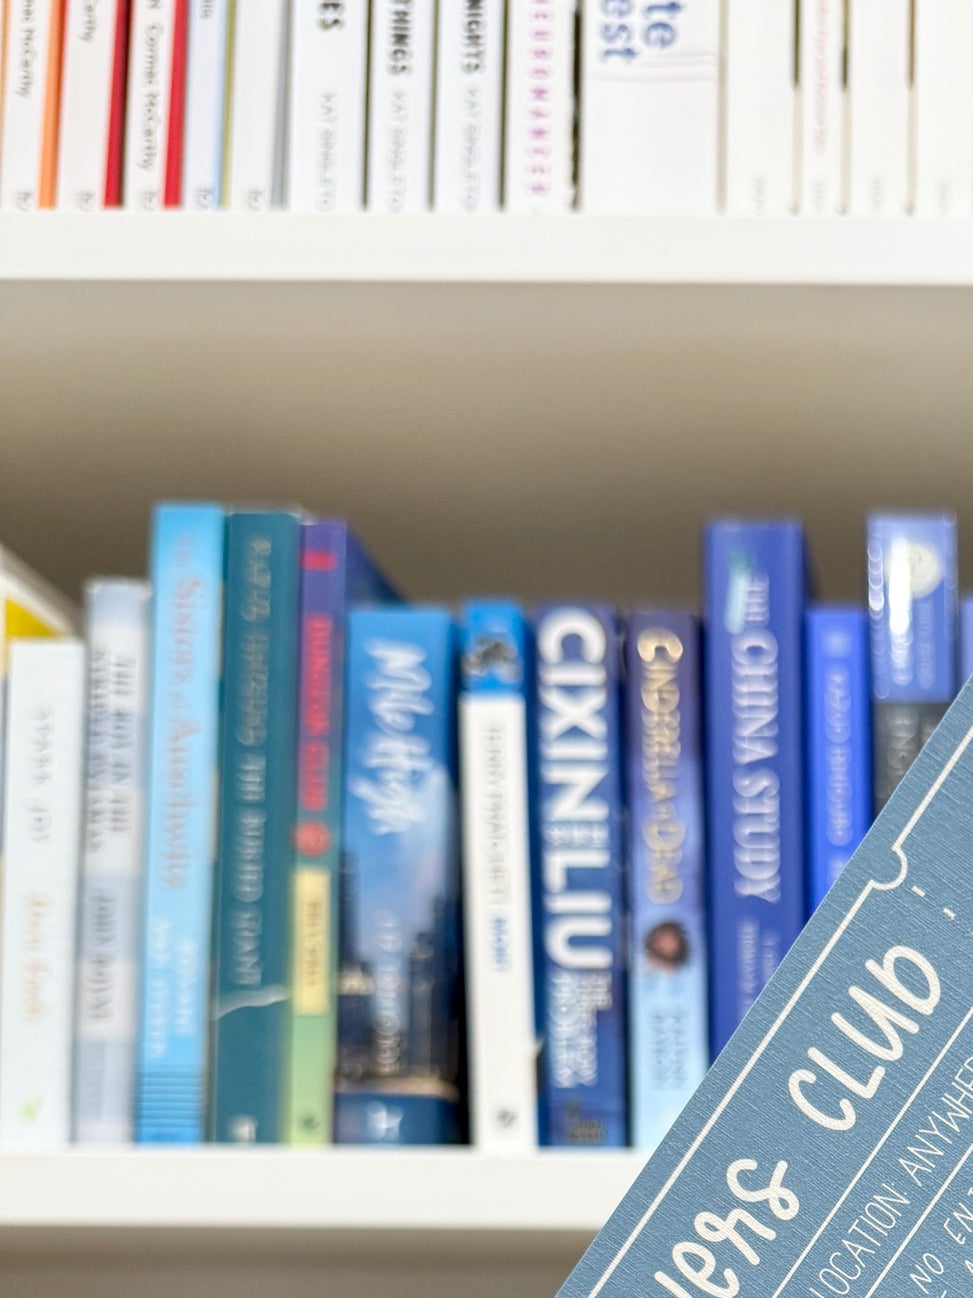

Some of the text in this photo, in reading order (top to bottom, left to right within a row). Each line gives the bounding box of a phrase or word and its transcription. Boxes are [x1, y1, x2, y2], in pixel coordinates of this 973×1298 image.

[733, 631, 778, 766] CHINA
[538, 608, 615, 970] CIXIN LIU
[734, 768, 781, 904] STUDY
[910, 1253, 944, 1294] NO
